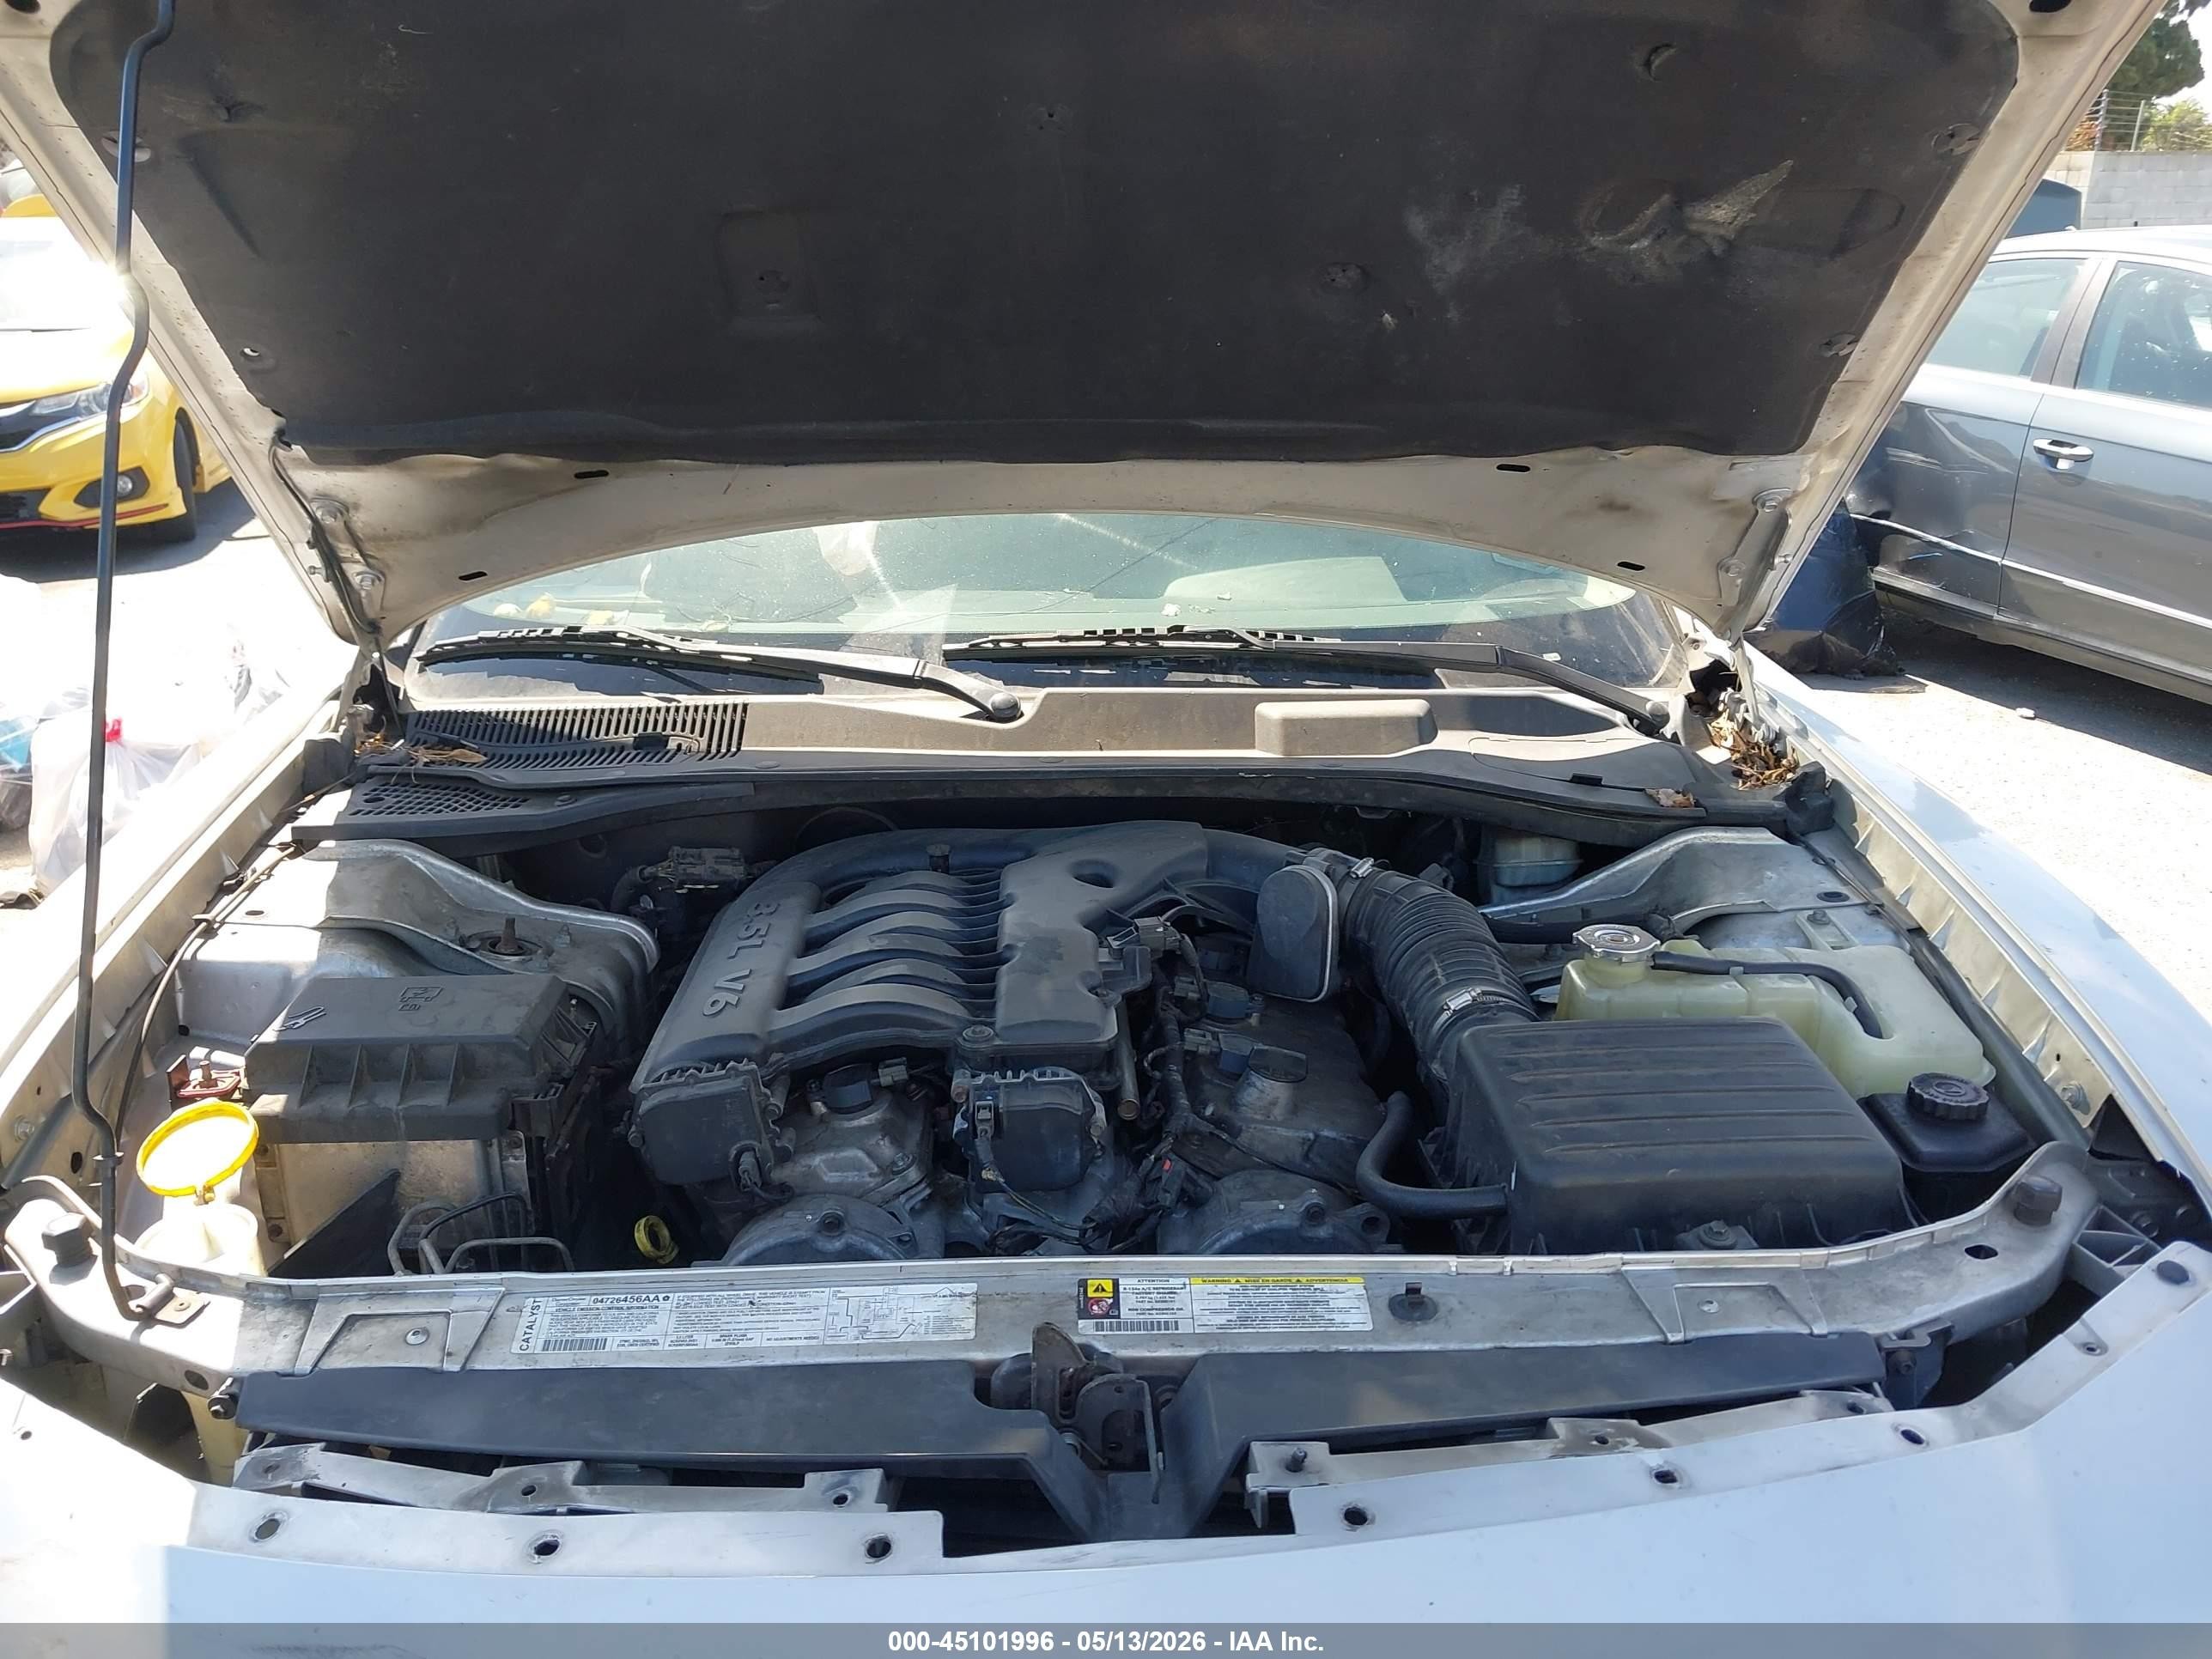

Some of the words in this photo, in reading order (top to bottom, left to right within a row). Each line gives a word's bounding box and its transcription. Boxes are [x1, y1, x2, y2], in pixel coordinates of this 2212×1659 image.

[727, 902, 781, 960] 3.5L
[702, 968, 752, 1017] V6
[592, 1295, 660, 1304] 04726456AA
[519, 1299, 543, 1352] CATALYST
